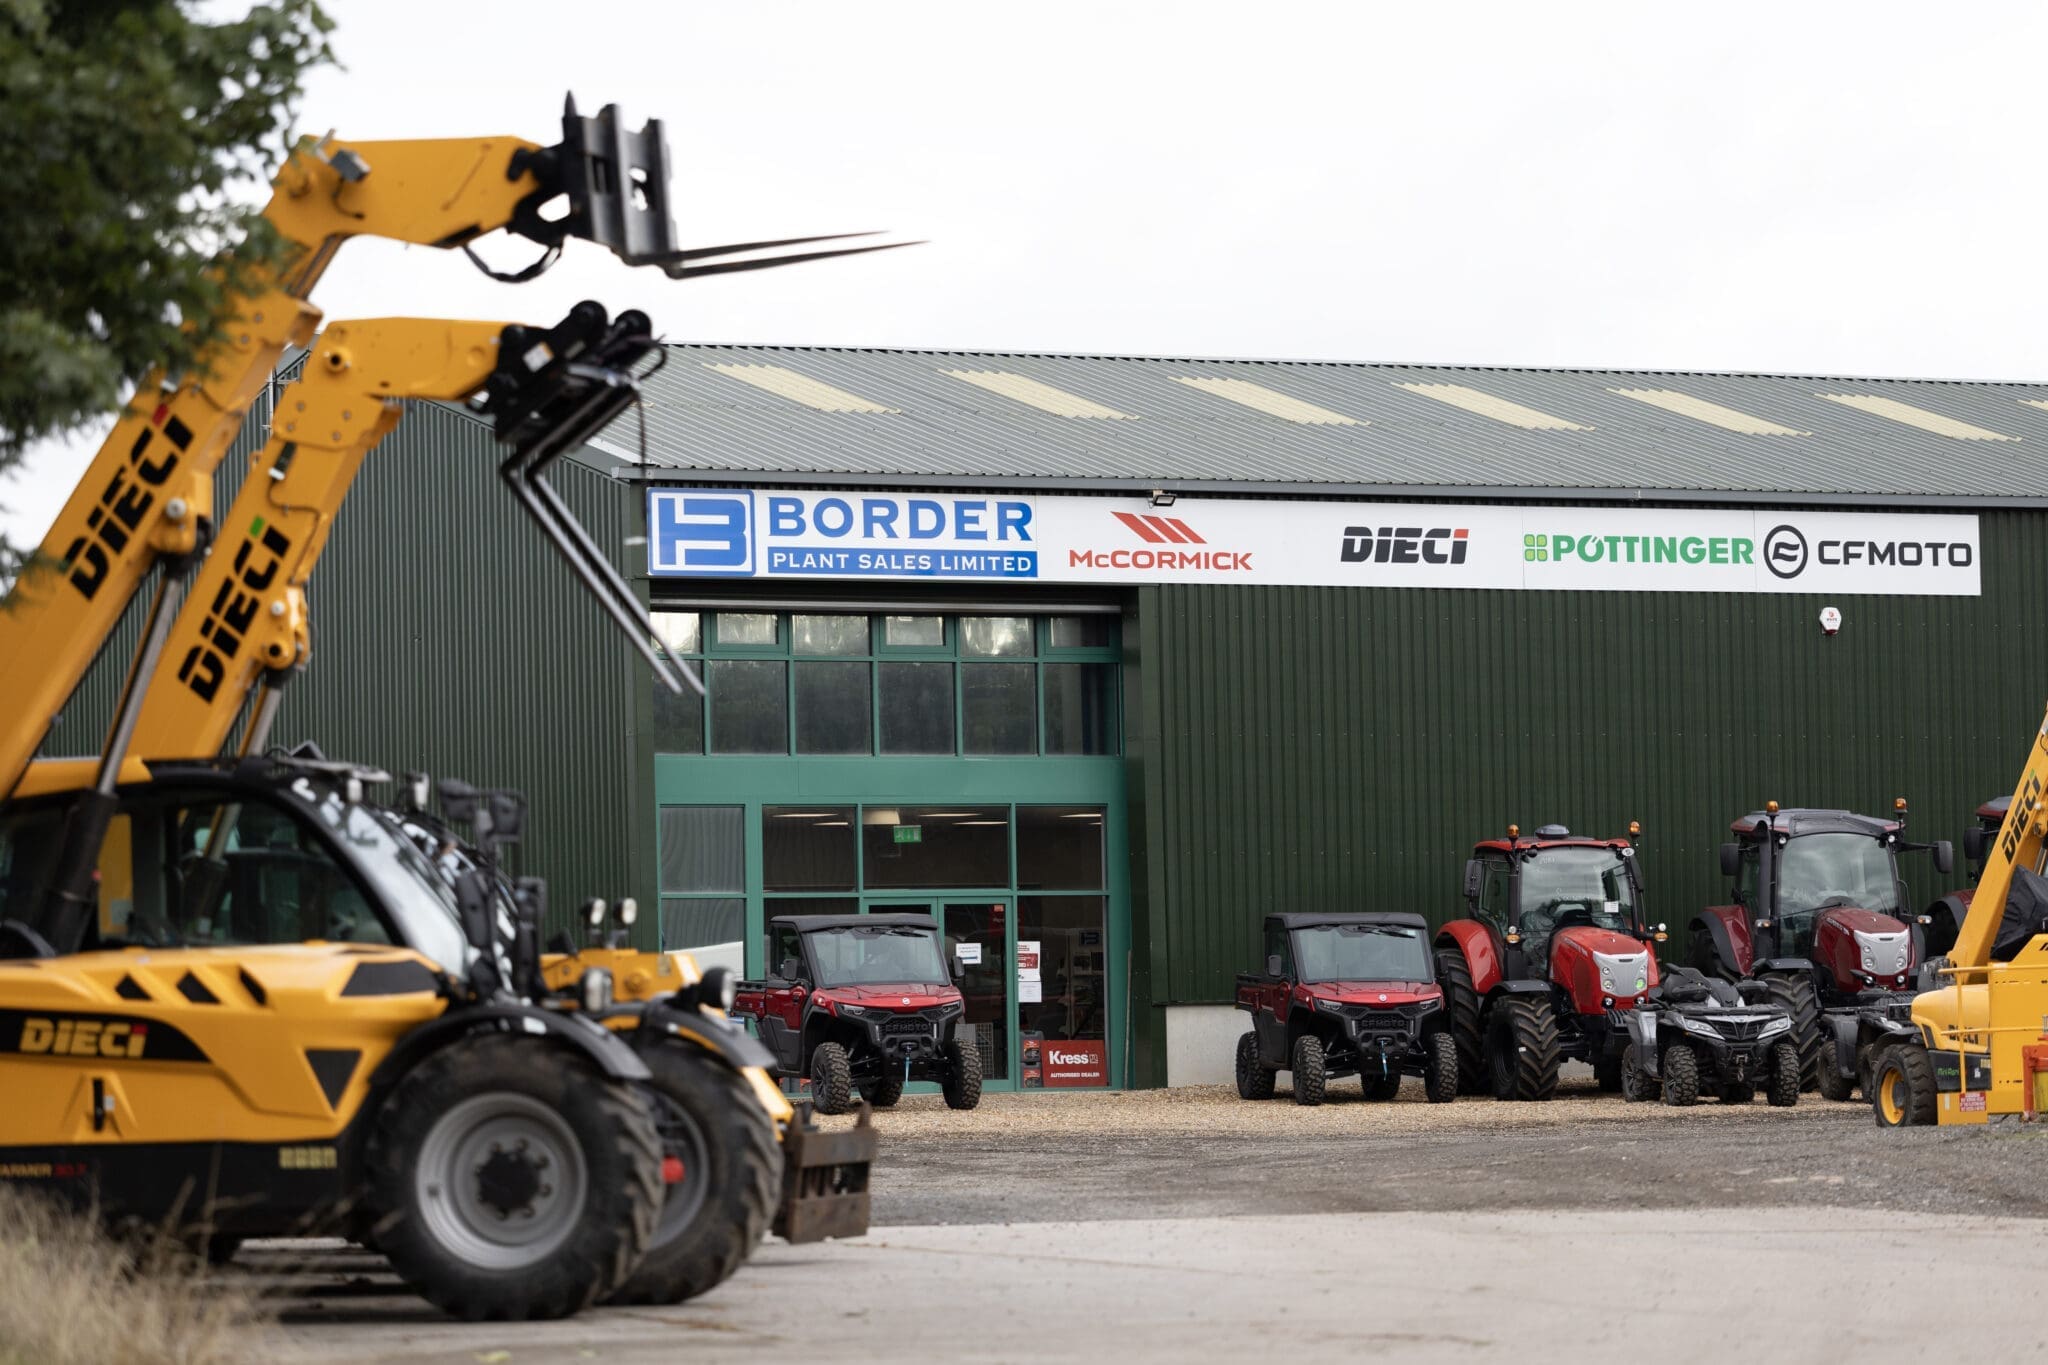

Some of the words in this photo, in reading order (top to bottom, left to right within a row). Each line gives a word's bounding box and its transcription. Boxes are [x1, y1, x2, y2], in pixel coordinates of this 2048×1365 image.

[60, 403, 194, 601] DIECI
[768, 497, 1033, 541] BORDER
[773, 552, 849, 569] PLANT
[858, 553, 932, 570] SALES
[940, 555, 1032, 572] LIMITED
[1069, 549, 1253, 571] McCORMICK
[1341, 526, 1469, 564] DIECI
[1817, 540, 1972, 567] CFMOTO
[178, 516, 290, 703] DIECI
[2001, 768, 2041, 865] DIECI
[19, 1017, 148, 1059] DIECI
[1048, 1050, 1089, 1065] Kress
